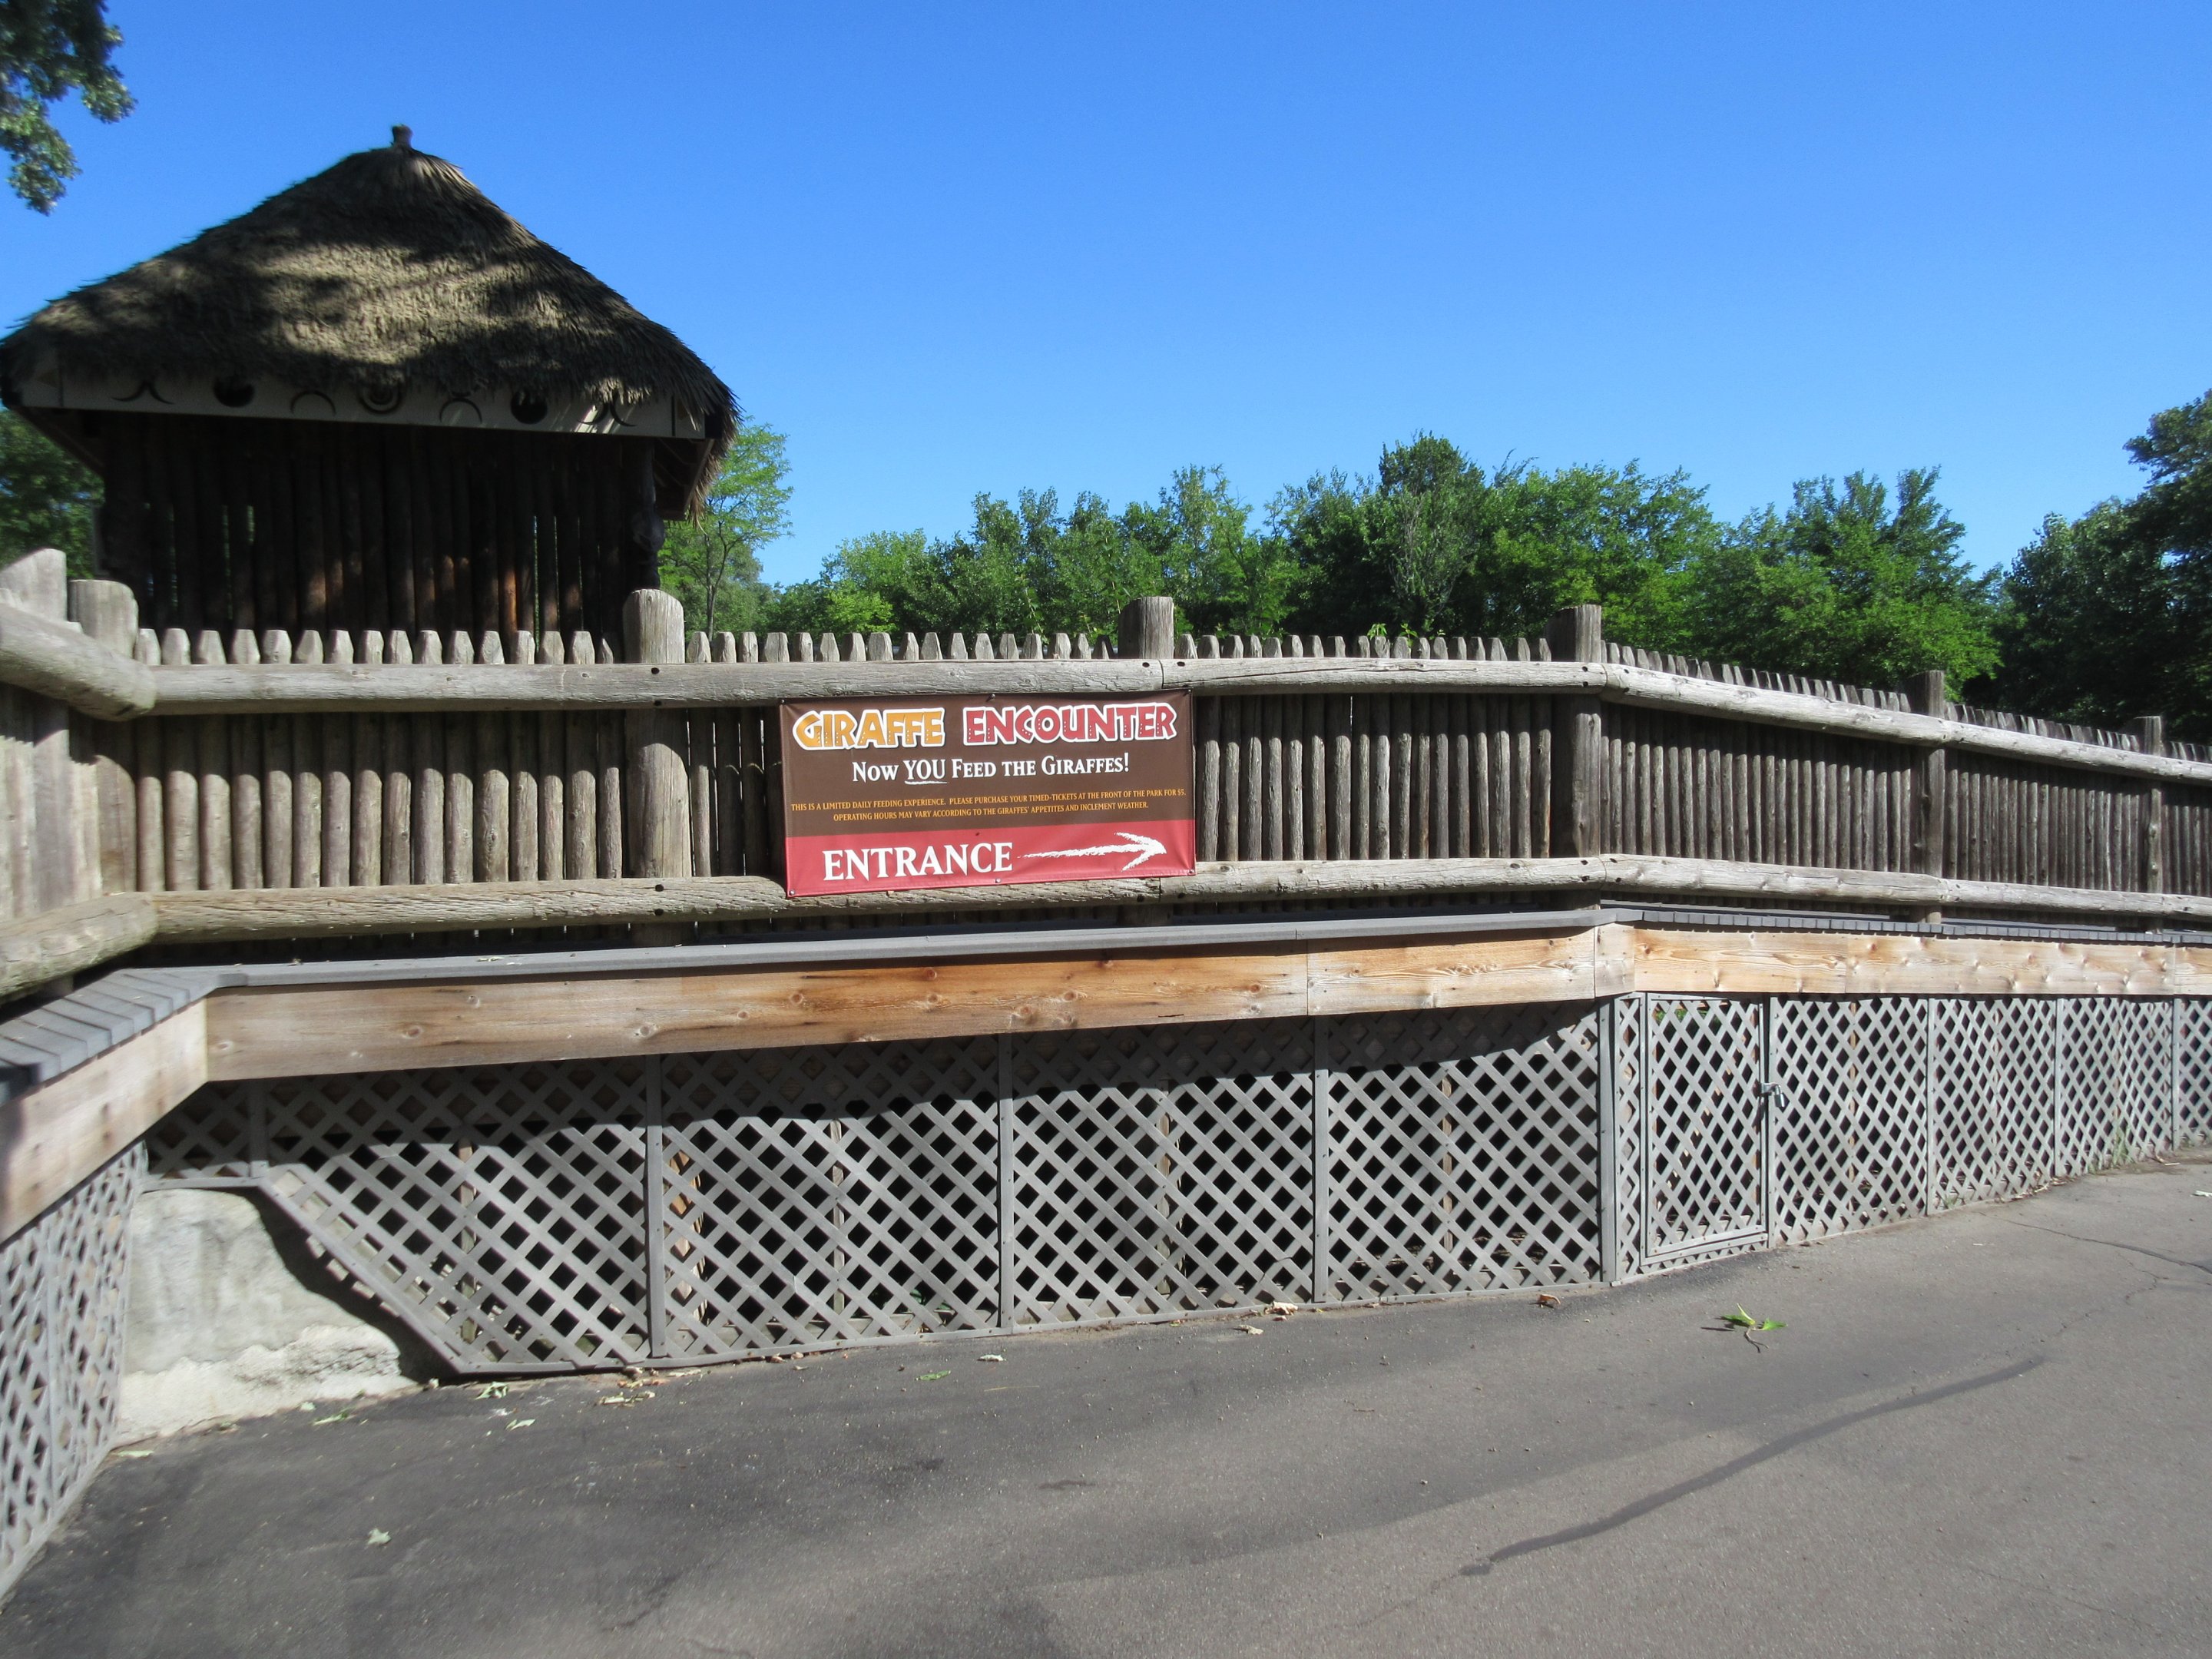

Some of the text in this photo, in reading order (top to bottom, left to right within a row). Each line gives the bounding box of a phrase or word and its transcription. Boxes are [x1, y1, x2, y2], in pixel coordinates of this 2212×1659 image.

[793, 703, 1177, 750] GIRAFFE ENCOUNTER
[903, 759, 946, 780] YOU
[952, 758, 997, 778] FEED
[1002, 760, 1036, 777] THE
[1041, 753, 1129, 775] GIRAFFES!
[833, 813, 873, 821] OPERATING
[932, 809, 972, 817] ACCORDING
[1031, 805, 1065, 813] APPETITES
[1080, 803, 1116, 811] INCLEMENT
[873, 800, 902, 808] FEEDING
[904, 798, 946, 806] EXPERIENCE.
[1029, 793, 1078, 802] TIMED-TICKETS
[823, 842, 1013, 881] ENTRANCE
